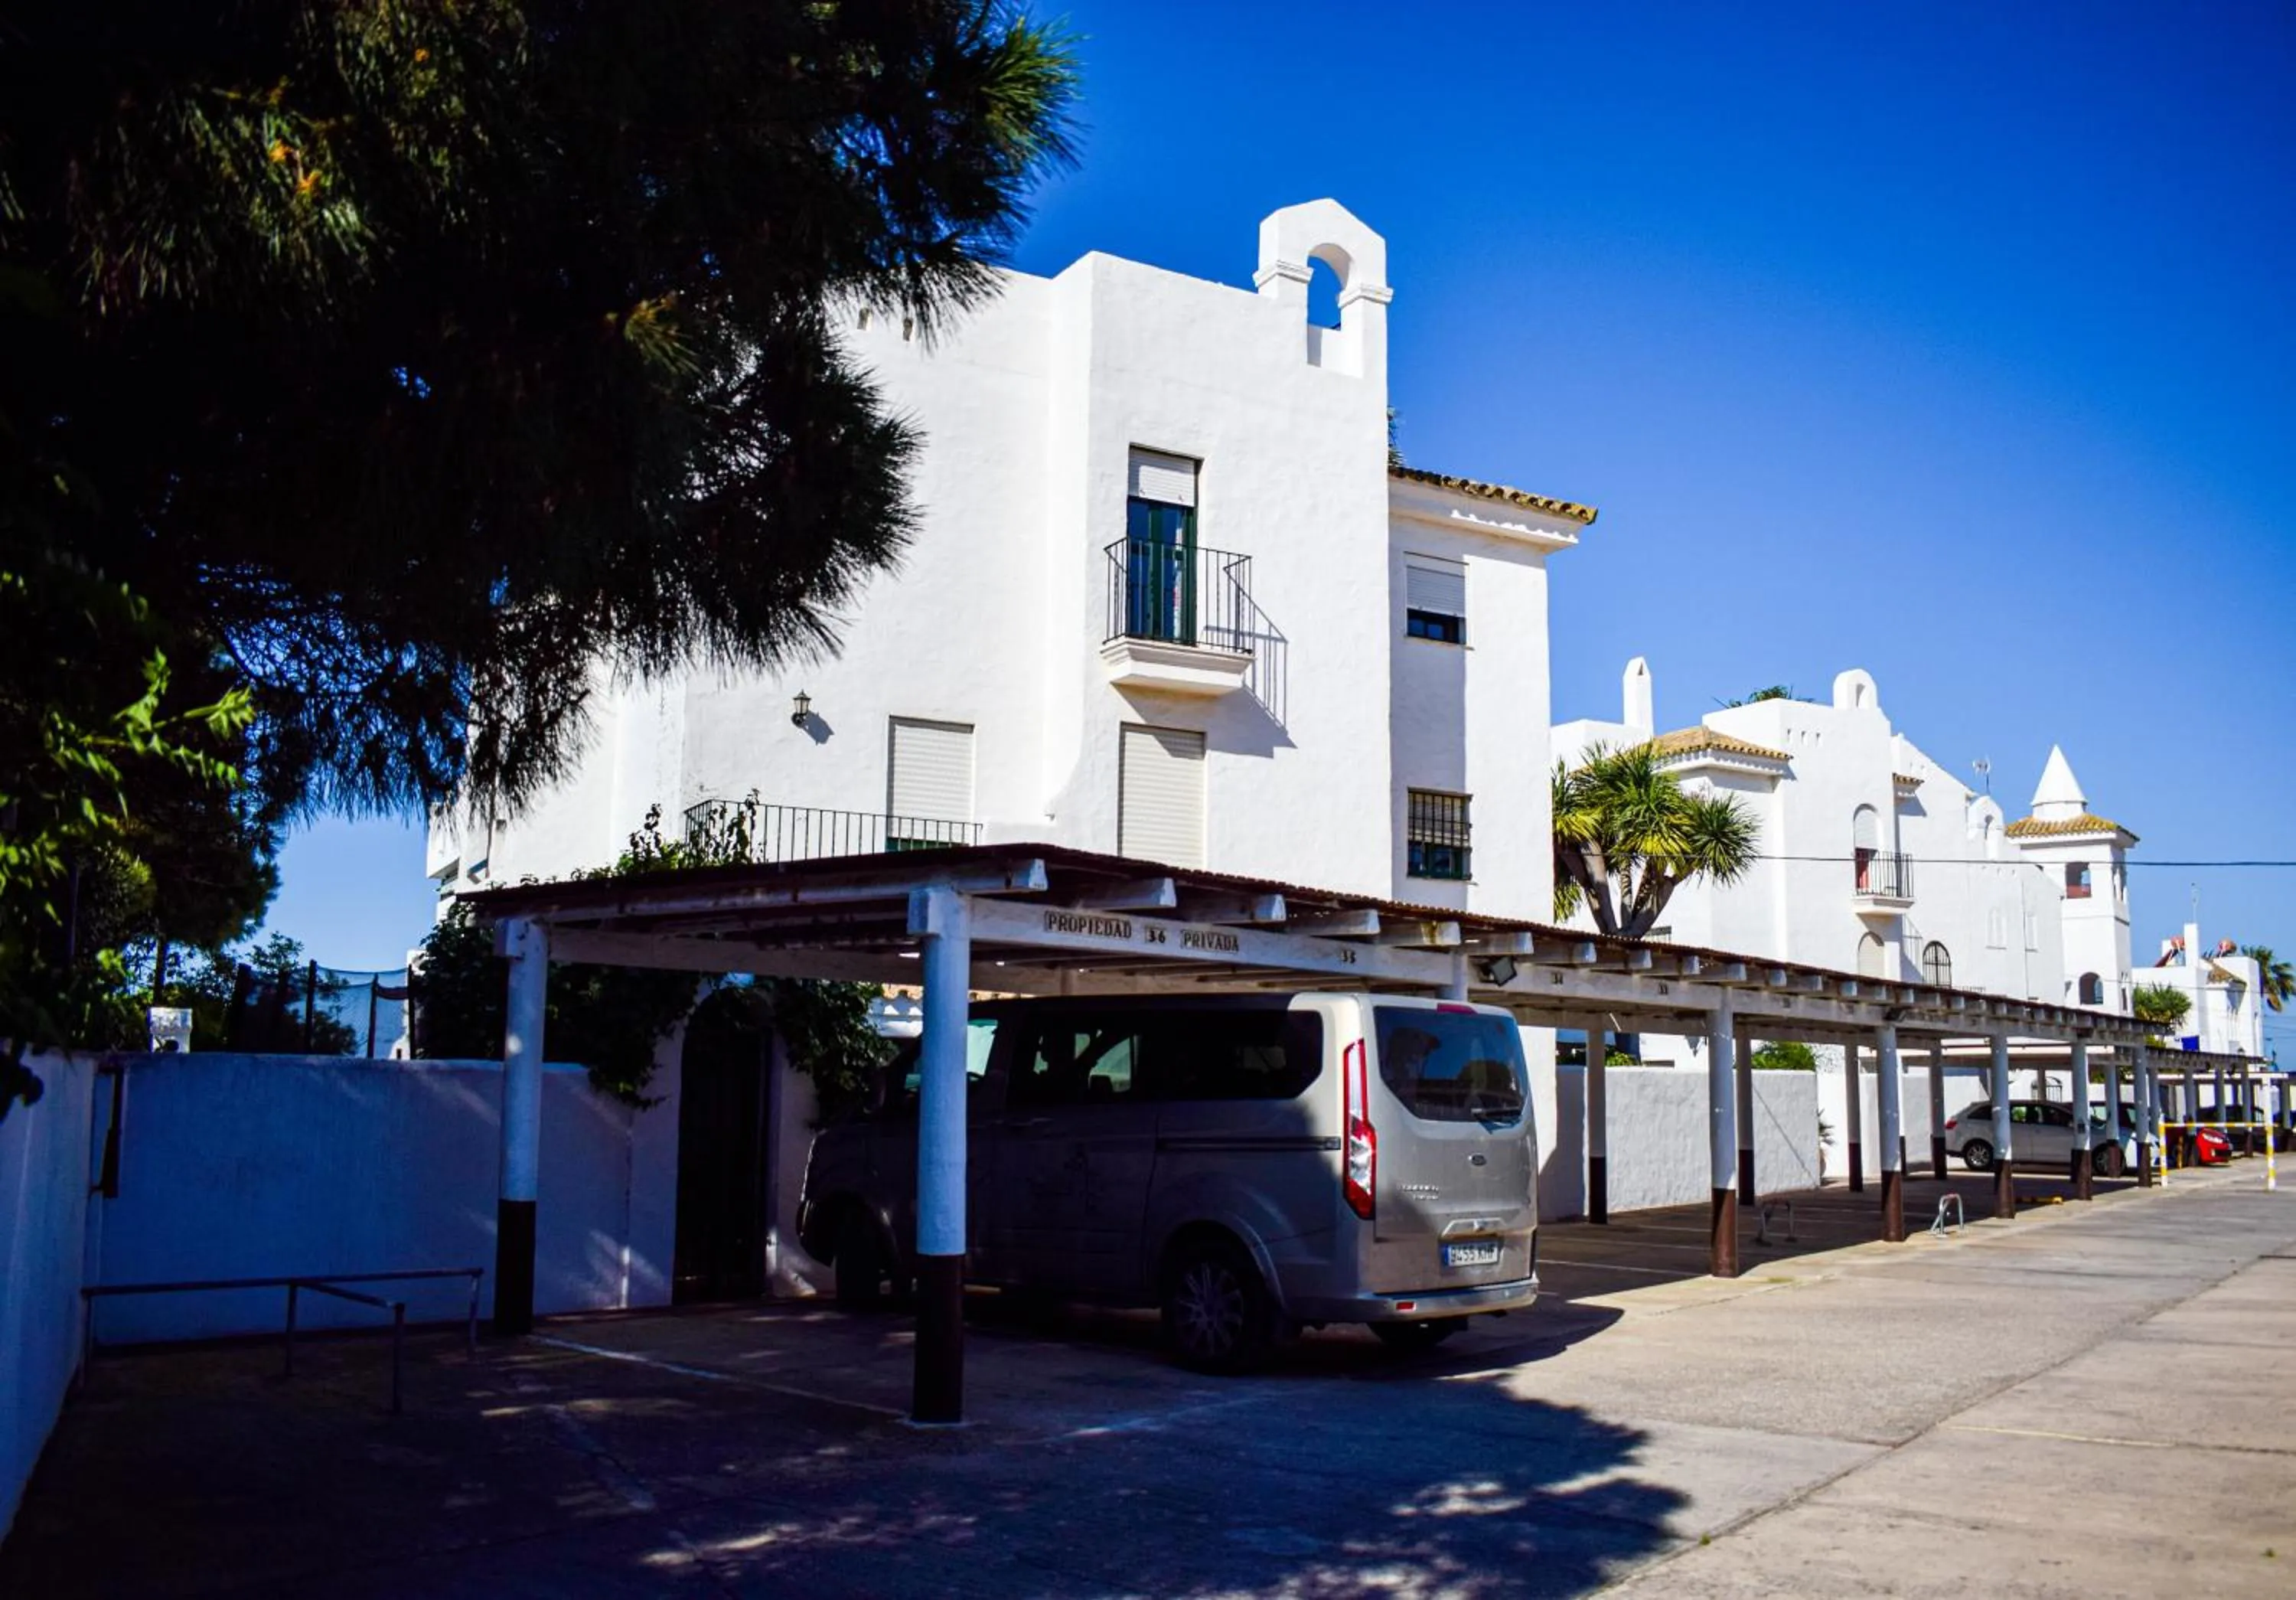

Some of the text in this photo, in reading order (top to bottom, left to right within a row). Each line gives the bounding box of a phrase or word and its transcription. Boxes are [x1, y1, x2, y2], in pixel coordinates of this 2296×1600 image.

[1047, 912, 1239, 952] PROPIEDAD 36 PRIVADA
